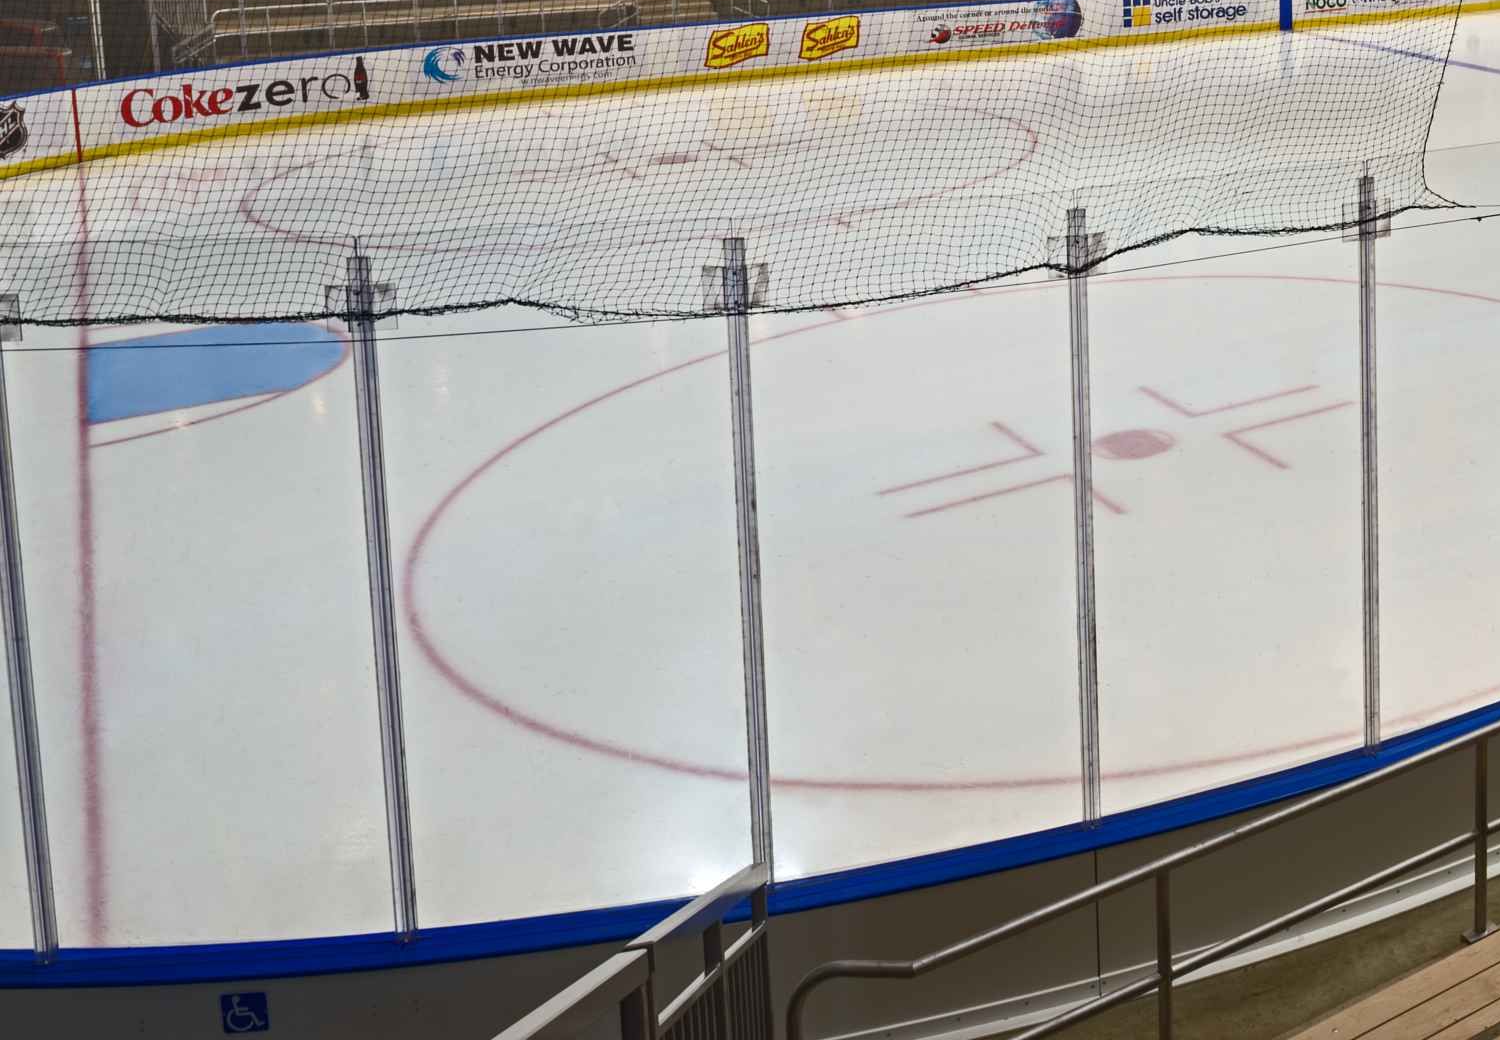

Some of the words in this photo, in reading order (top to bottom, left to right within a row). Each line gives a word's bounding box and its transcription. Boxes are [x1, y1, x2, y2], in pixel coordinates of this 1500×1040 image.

[1154, 9, 1183, 24] self
[1188, 4, 1247, 21] storage
[806, 24, 855, 52] Sahlen's
[954, 22, 1005, 35] SPEED
[474, 41, 543, 63] NEW
[552, 34, 634, 57] WAVE
[712, 32, 764, 59] Sahlen's
[475, 64, 533, 79] Energy
[538, 55, 636, 75] Corporation
